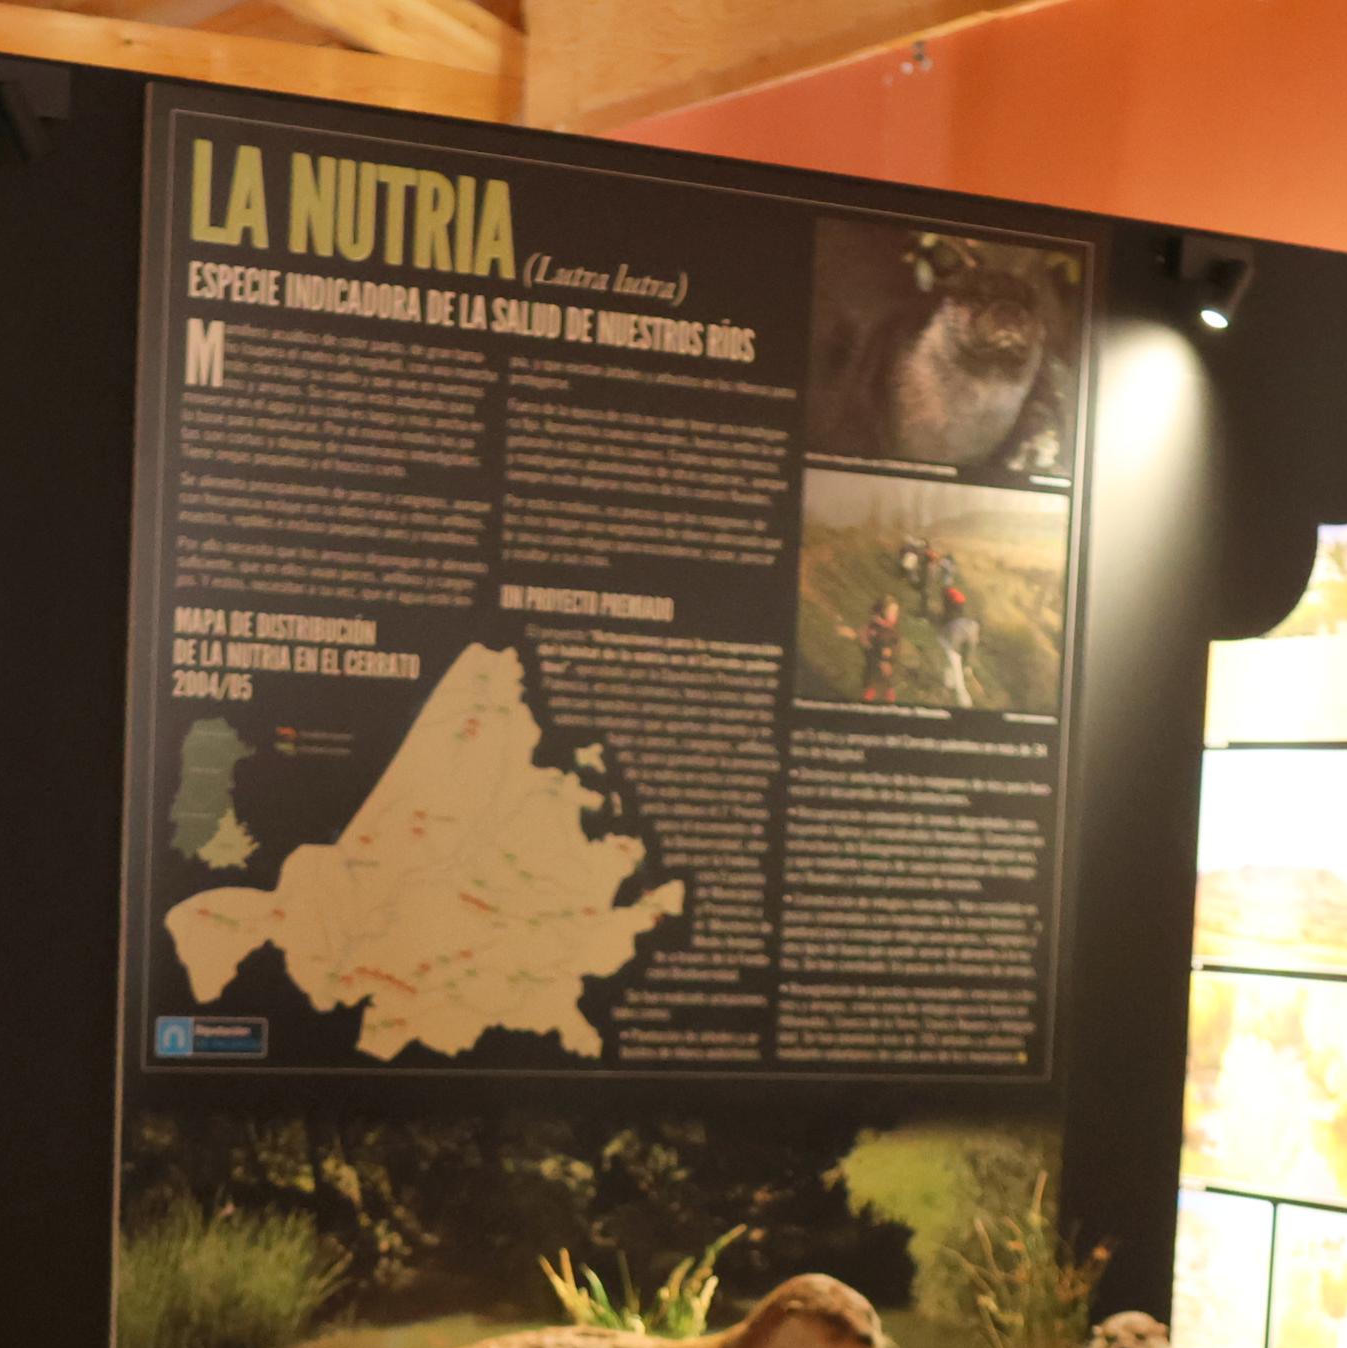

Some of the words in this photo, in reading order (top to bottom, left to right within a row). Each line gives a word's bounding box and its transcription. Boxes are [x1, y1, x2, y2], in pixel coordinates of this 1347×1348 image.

[190, 138, 269, 249] LA
[288, 151, 516, 280] NUTRIA
[523, 252, 610, 291] (Lutra
[612, 263, 688, 307] lutra)
[188, 260, 281, 307] ESPECIE
[284, 271, 422, 324] INDICADORA
[425, 289, 457, 328] DE
[458, 292, 488, 331] LA
[490, 297, 562, 339] SALUD
[564, 306, 594, 344] DE
[596, 310, 705, 357] NUESTROS
[706, 317, 756, 364] RÍOS
[173, 605, 227, 637] MAPA
[228, 609, 254, 638] DE
[255, 612, 378, 646] DISTRIBUCIÓN
[172, 637, 198, 667] DE
[199, 639, 224, 667] LA
[225, 641, 292, 671] NUTRIA
[293, 645, 320, 674] EN
[320, 647, 343, 676] EL
[343, 649, 422, 680] CERRATO
[171, 669, 253, 701] 2004/05
